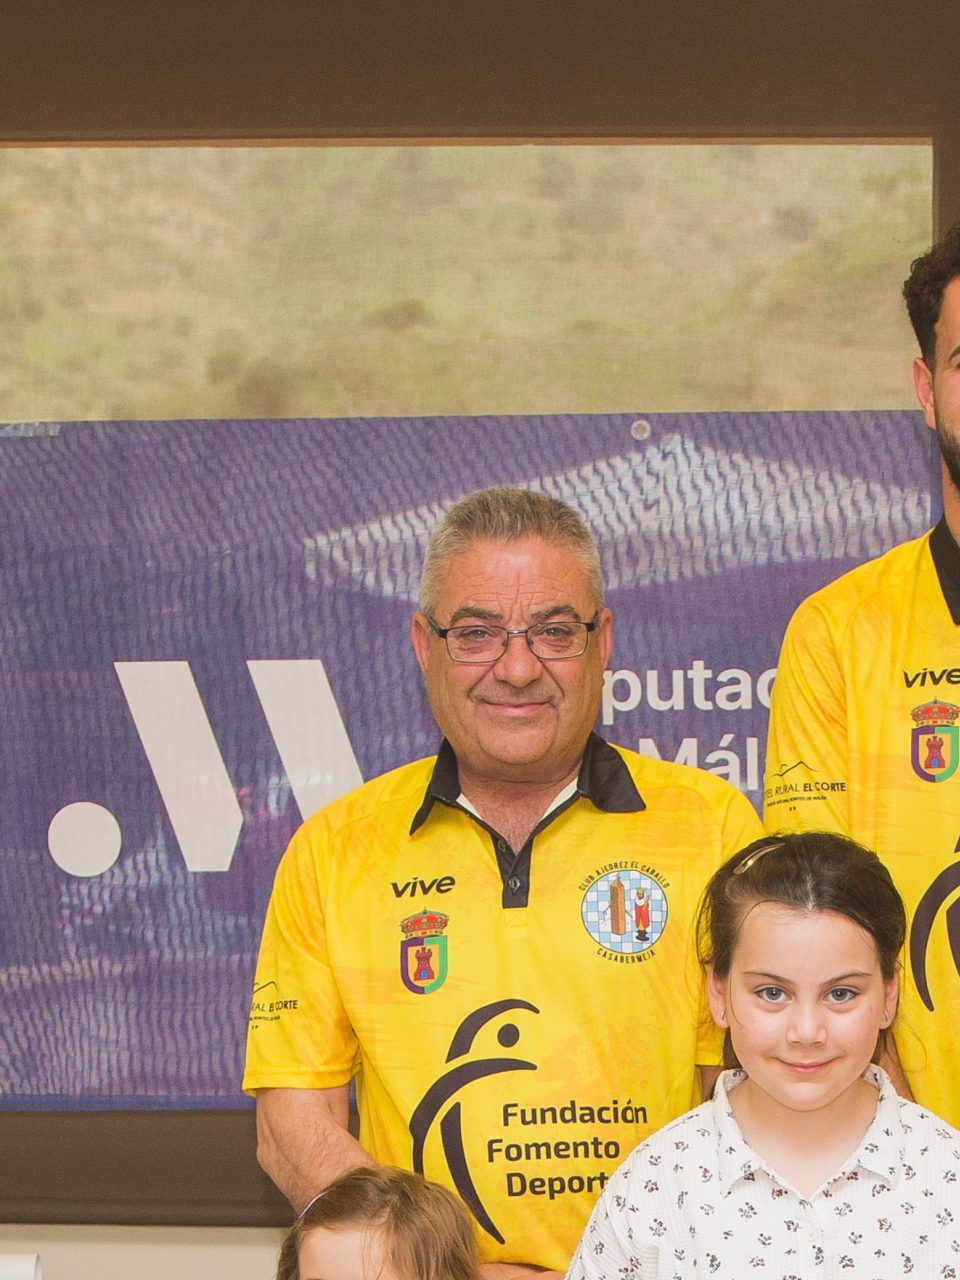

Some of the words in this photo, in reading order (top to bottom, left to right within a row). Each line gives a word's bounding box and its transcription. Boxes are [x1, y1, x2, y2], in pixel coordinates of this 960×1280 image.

[802, 782, 813, 792] EL
[814, 781, 847, 792] CORTE
[390, 876, 456, 898] vive
[578, 874, 596, 892] CLUB
[595, 861, 629, 877] AJEDREZ
[630, 860, 639, 869] EL
[640, 864, 671, 889] CABALLO
[596, 947, 657, 964] CASABERMEJA
[502, 1099, 648, 1127] Fundación
[487, 1136, 620, 1163] Fomento
[506, 1171, 608, 1200] Deport
